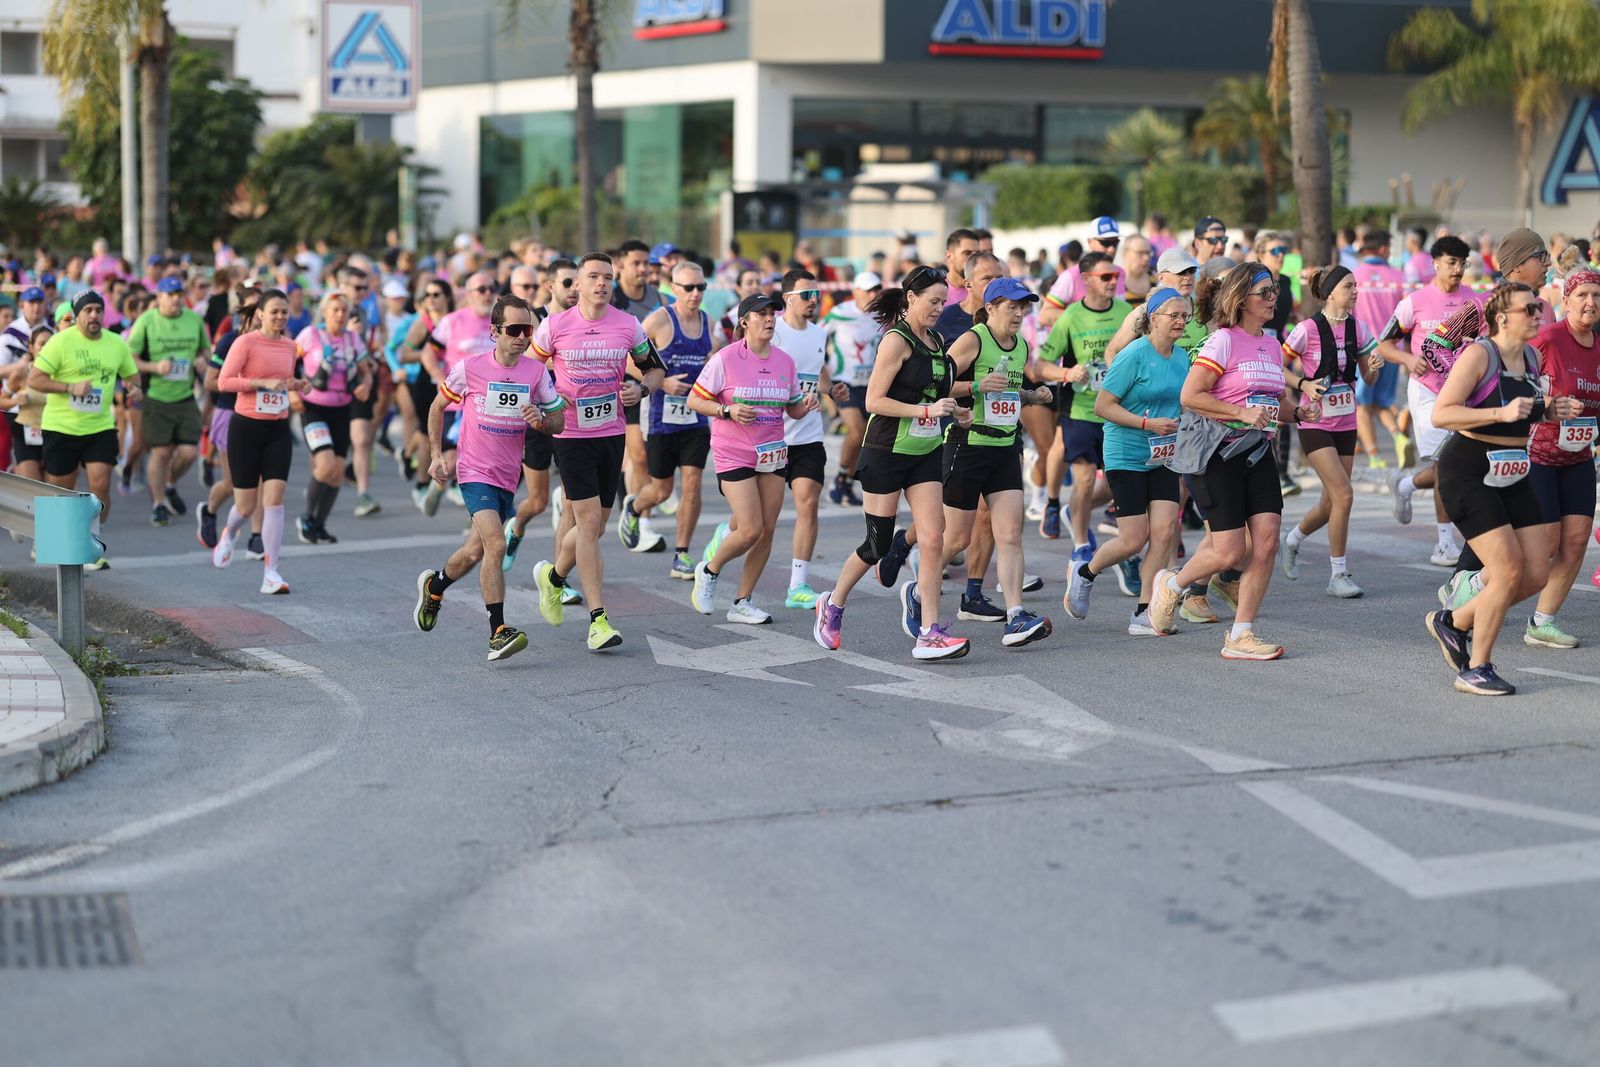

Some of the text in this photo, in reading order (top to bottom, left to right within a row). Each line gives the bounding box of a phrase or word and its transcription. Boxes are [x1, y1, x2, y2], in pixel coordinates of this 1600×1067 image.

[932, 0, 1106, 47] ALDI
[1238, 361, 1264, 371] MEDIA
[570, 376, 618, 385] TORREMOLINO
[263, 393, 284, 405] 821
[499, 393, 518, 406] 99
[735, 387, 761, 398] MEDIA
[1328, 392, 1351, 406] 918
[584, 402, 612, 419] 879
[991, 401, 1016, 415] 984
[1566, 427, 1593, 442] 335
[760, 448, 787, 464] 2170
[1152, 443, 1175, 459] 242
[1493, 461, 1528, 477] 1088
